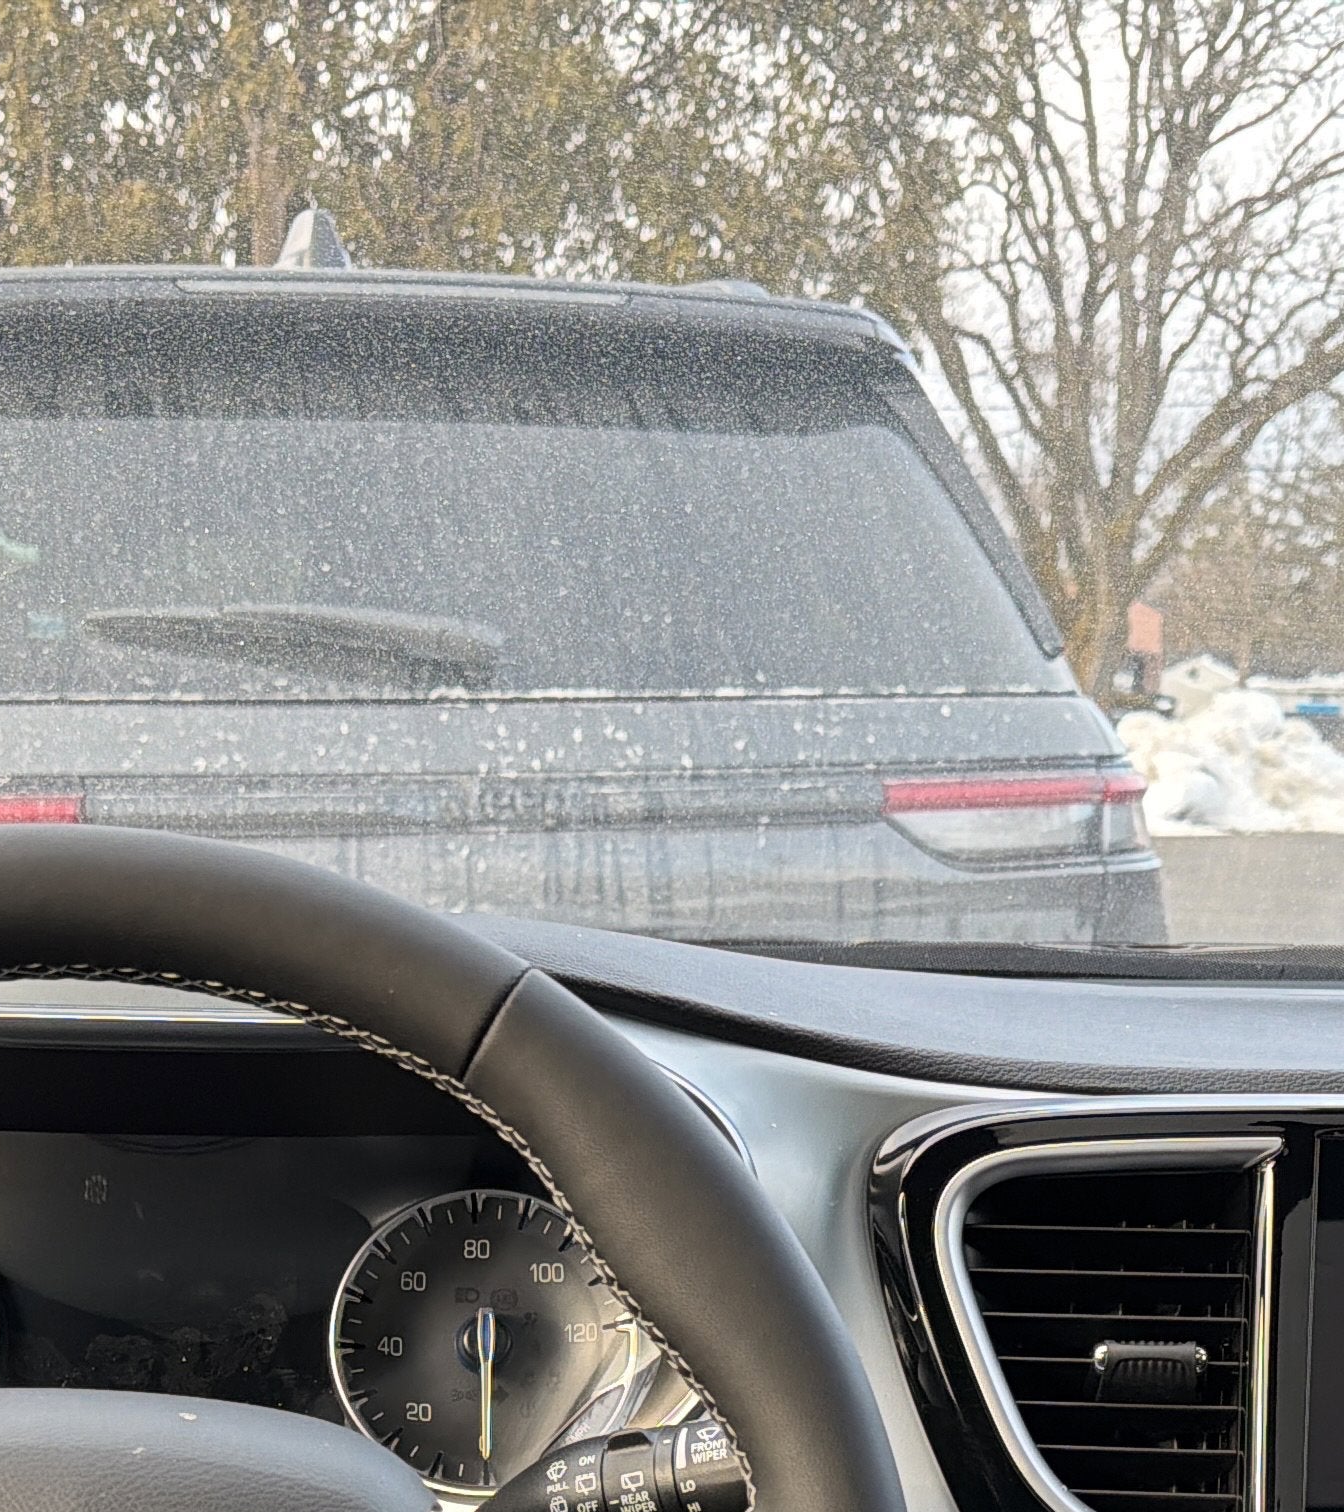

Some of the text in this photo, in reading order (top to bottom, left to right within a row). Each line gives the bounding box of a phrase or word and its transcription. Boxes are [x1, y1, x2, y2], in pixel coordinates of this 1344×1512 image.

[463, 1239, 490, 1259] 80
[529, 1262, 565, 1283] 100
[400, 1271, 426, 1292] 60
[563, 1322, 598, 1343] 120
[377, 1336, 403, 1357] 40
[405, 1403, 432, 1422] 20
[690, 1438, 728, 1454] FRONT
[578, 1454, 596, 1467] ON
[691, 1449, 728, 1464] WIPER
[546, 1481, 570, 1495] PULL
[680, 1480, 696, 1493] LO
[620, 1490, 650, 1506] REAR
